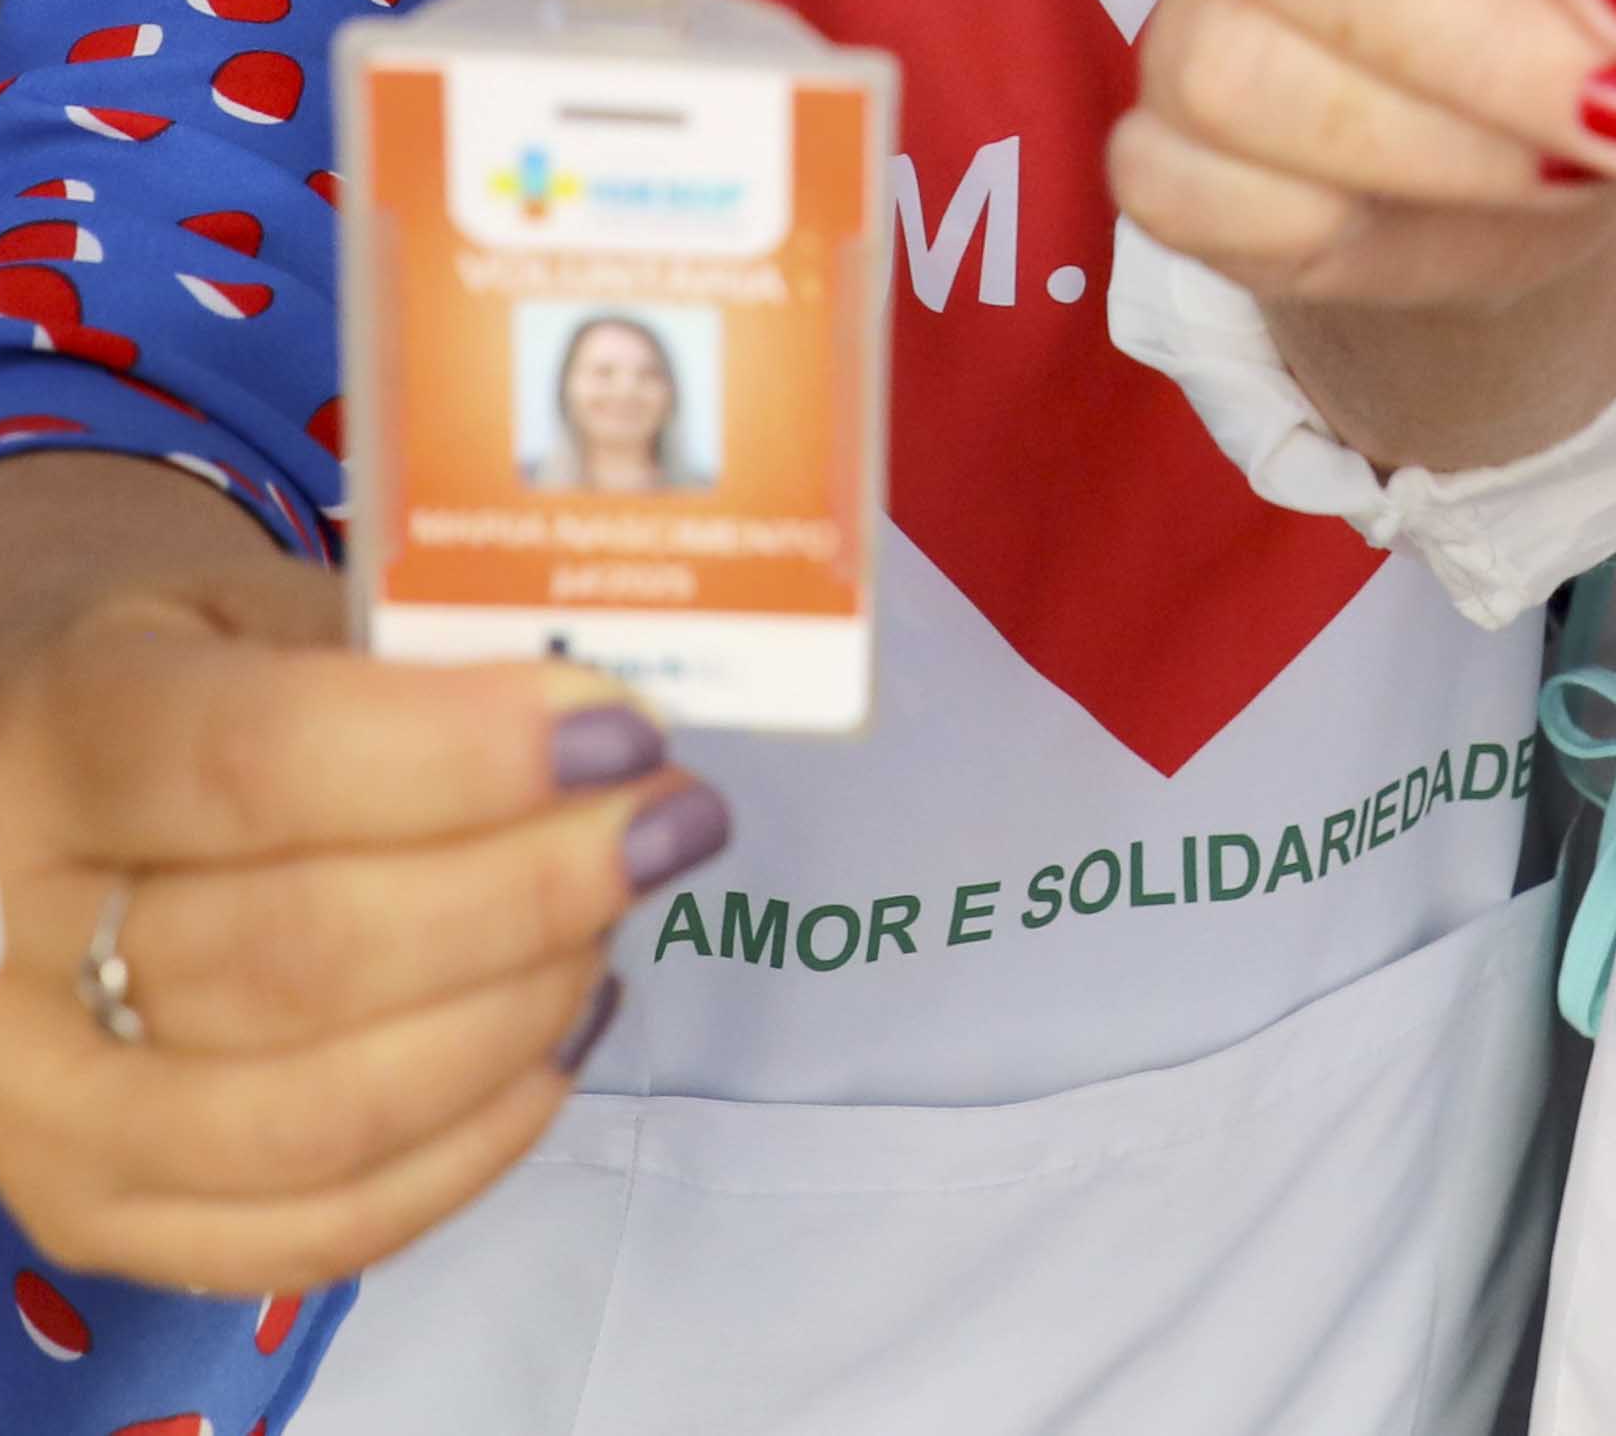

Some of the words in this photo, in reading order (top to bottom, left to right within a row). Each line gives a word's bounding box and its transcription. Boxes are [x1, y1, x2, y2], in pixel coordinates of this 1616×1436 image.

[653, 890, 922, 974] AMOR
[944, 880, 1002, 947] E
[1019, 734, 1537, 930] SOLIDARIEDADE
